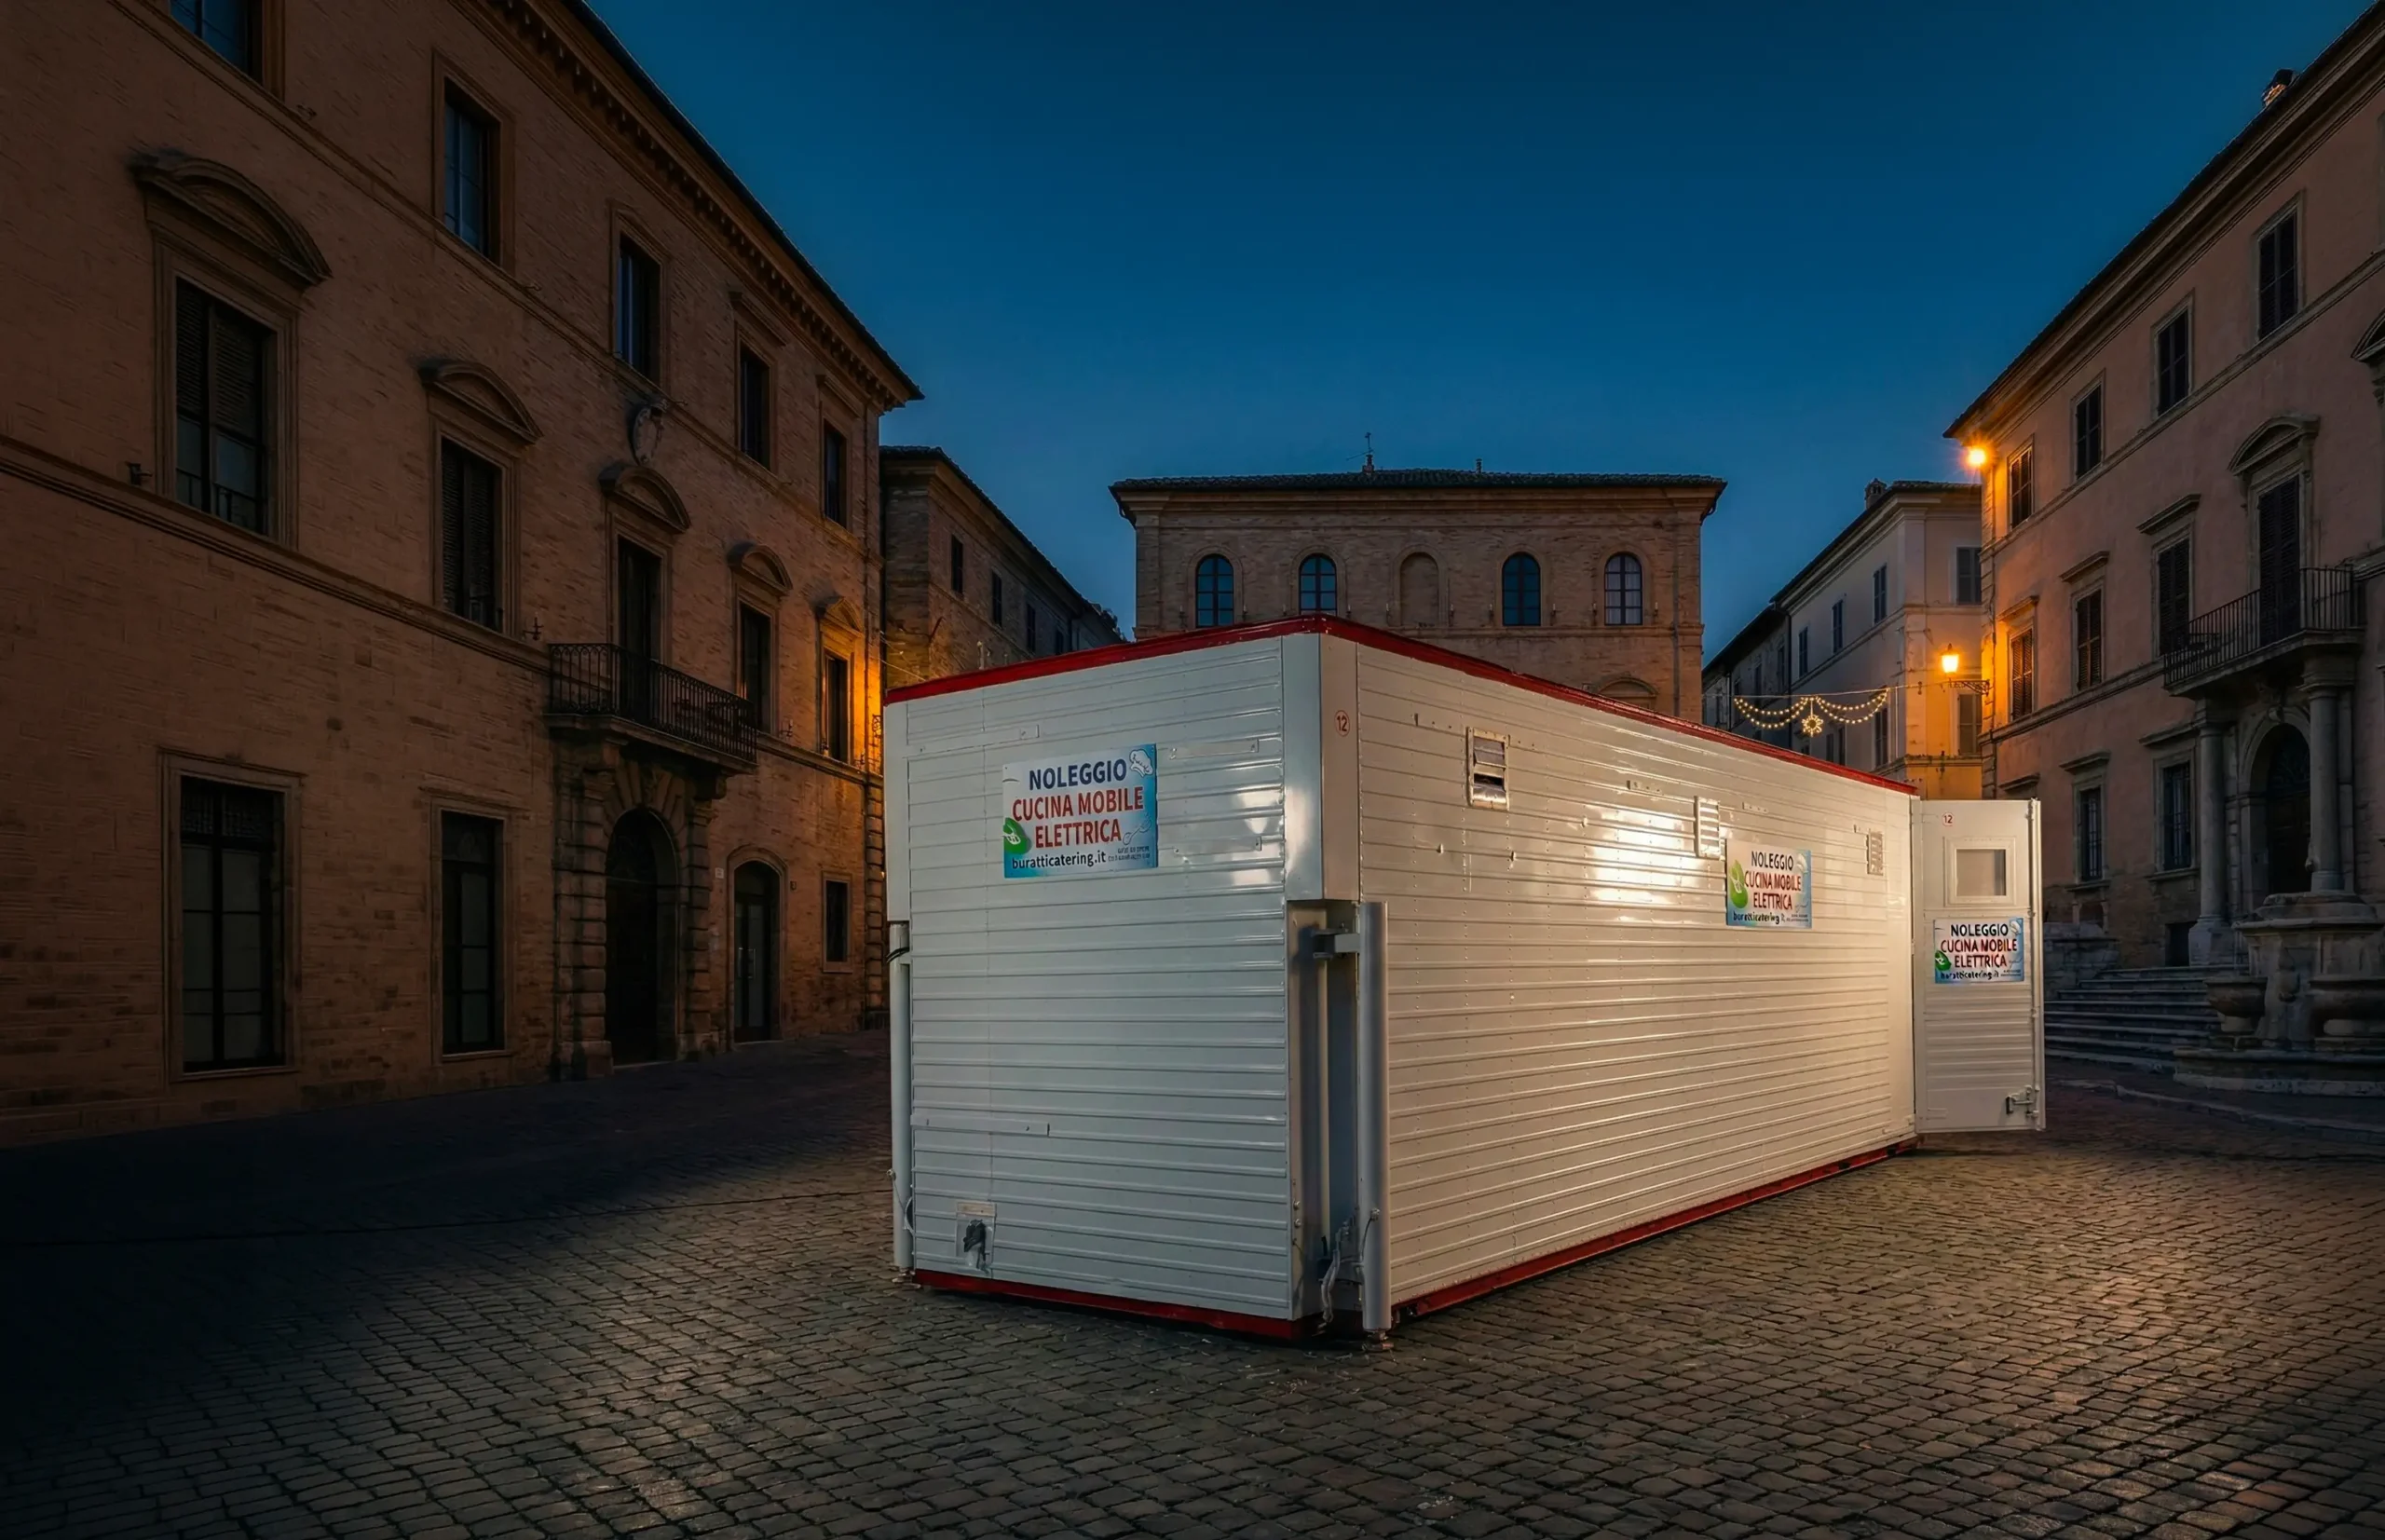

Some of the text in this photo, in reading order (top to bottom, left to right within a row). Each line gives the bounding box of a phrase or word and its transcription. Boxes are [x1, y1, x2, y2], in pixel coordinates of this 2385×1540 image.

[1337, 715, 1347, 731] 12
[1029, 758, 1127, 791] NOLEGGIO
[1013, 786, 1144, 822] CUCINA MOBILE
[1035, 818, 1122, 849] ELETTRICA
[1012, 849, 1107, 869] buratticatering.it
[1751, 851, 1794, 871] NOLEGGIO
[1744, 870, 1802, 892] CUCINA MOBILE
[1753, 893, 1792, 910] ELETTRICA
[1950, 923, 2009, 937] NOLEGGIO
[1941, 939, 1978, 953] CUCINA
[1955, 954, 2007, 968] ELETTRICA
